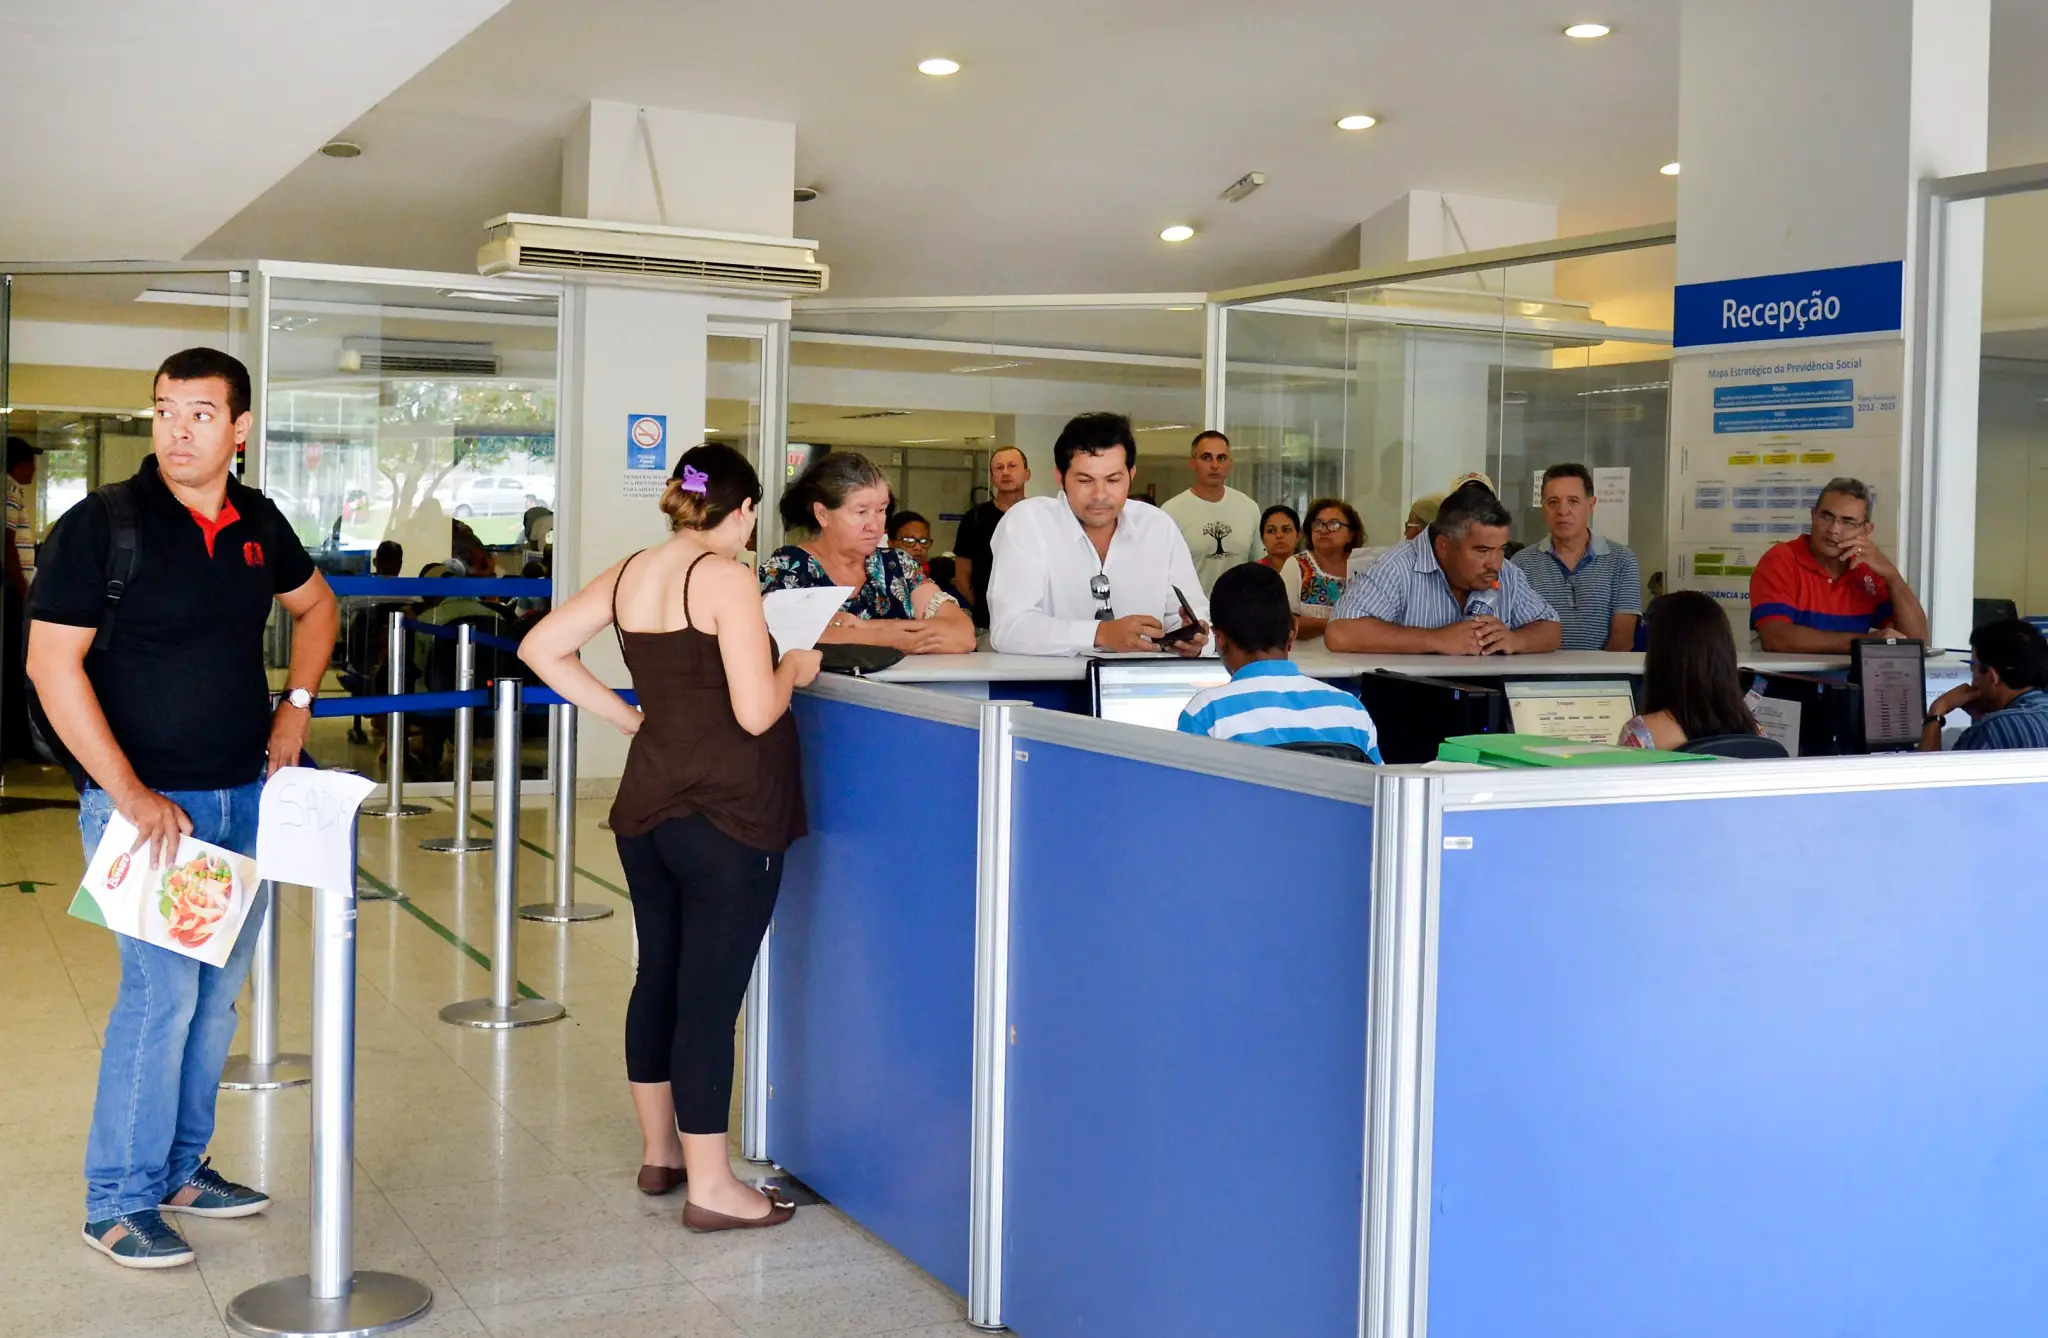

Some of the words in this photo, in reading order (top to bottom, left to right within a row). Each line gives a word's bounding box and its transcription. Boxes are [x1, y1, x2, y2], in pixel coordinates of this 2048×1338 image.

[1722, 289, 1841, 332] Recepção
[1708, 368, 1729, 379] Mapa
[1730, 364, 1772, 377] Estratégico
[1774, 363, 1785, 374] da
[1786, 360, 1834, 373] Previdência
[1836, 358, 1862, 370] Social
